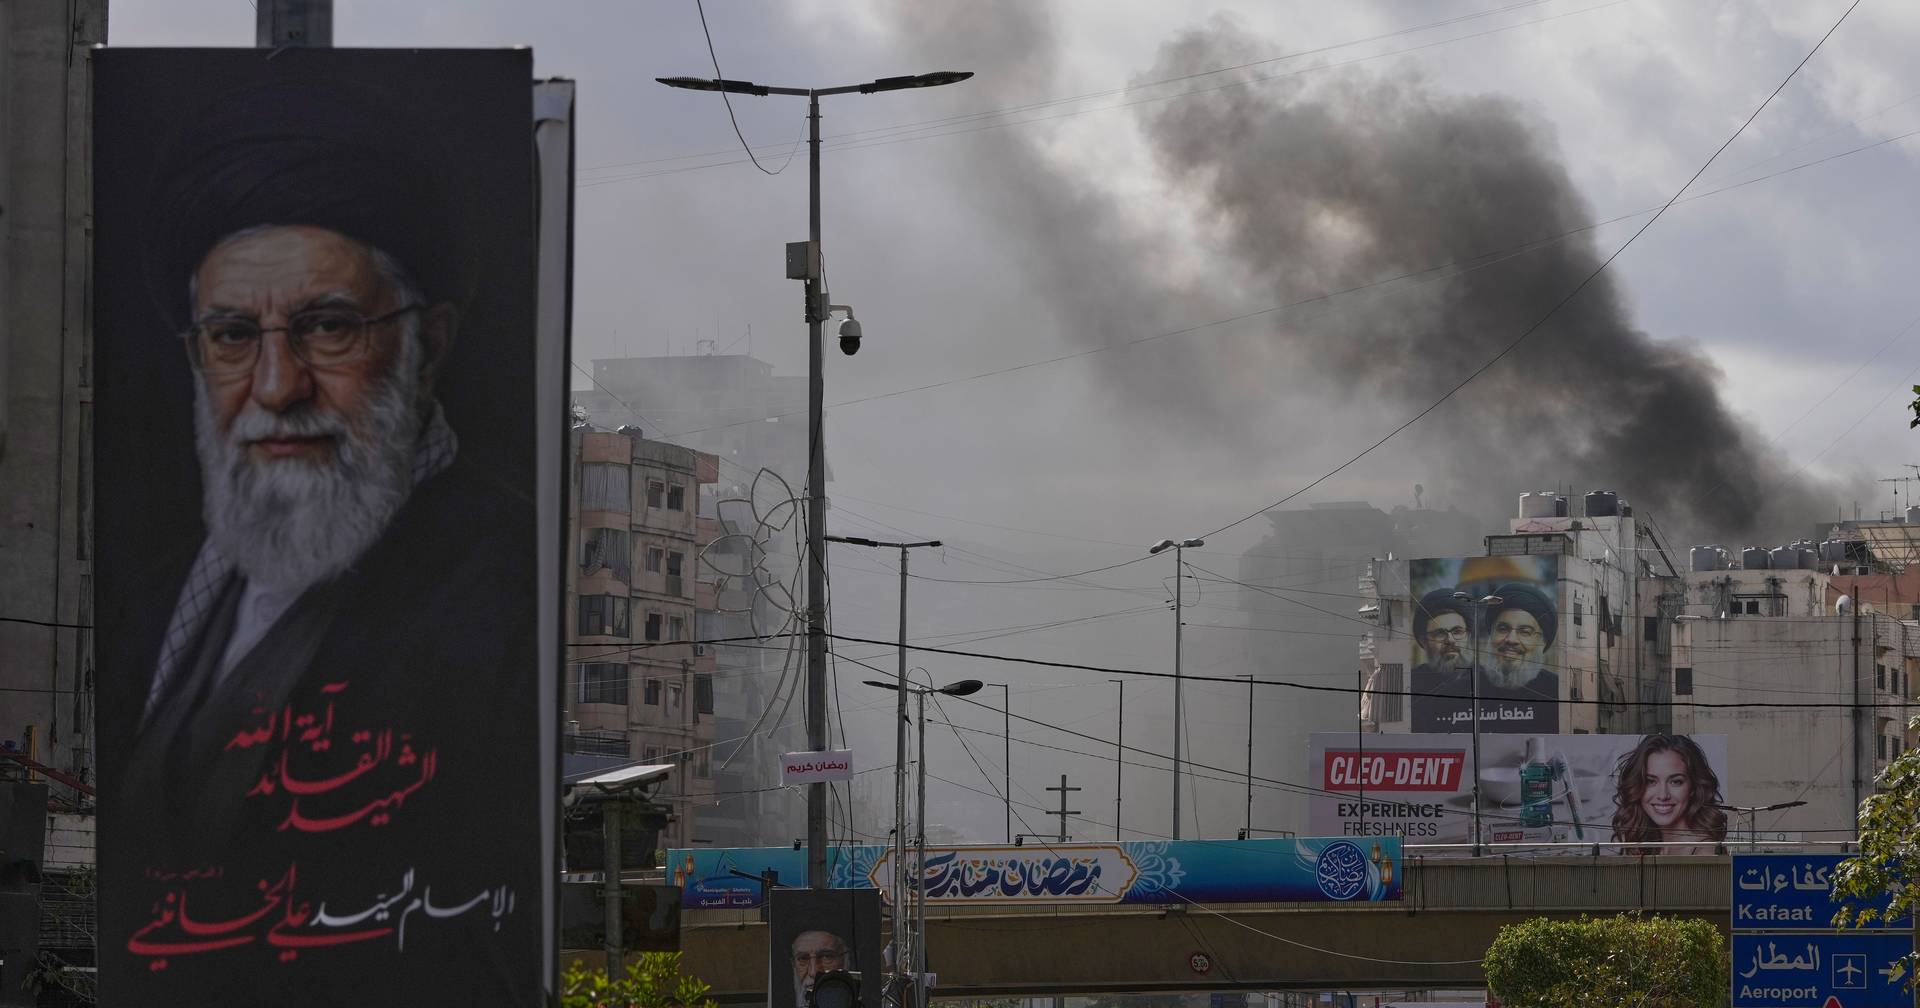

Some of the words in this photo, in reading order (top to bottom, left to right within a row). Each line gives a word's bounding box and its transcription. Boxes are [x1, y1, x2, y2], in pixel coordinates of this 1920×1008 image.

[787, 763, 813, 774] كريم
[815, 760, 848, 772] رمضان
[1330, 756, 1454, 785] CLEO-DENT
[1338, 803, 1443, 818] EXPERIENCE
[1343, 821, 1438, 836] FRESHNESS
[1001, 857, 1102, 896] رمضان
[1738, 863, 1829, 894] كفاءات
[1738, 903, 1813, 921] Kafaat
[1739, 941, 1821, 979] المطار
[1739, 985, 1819, 1002] Aeroport
